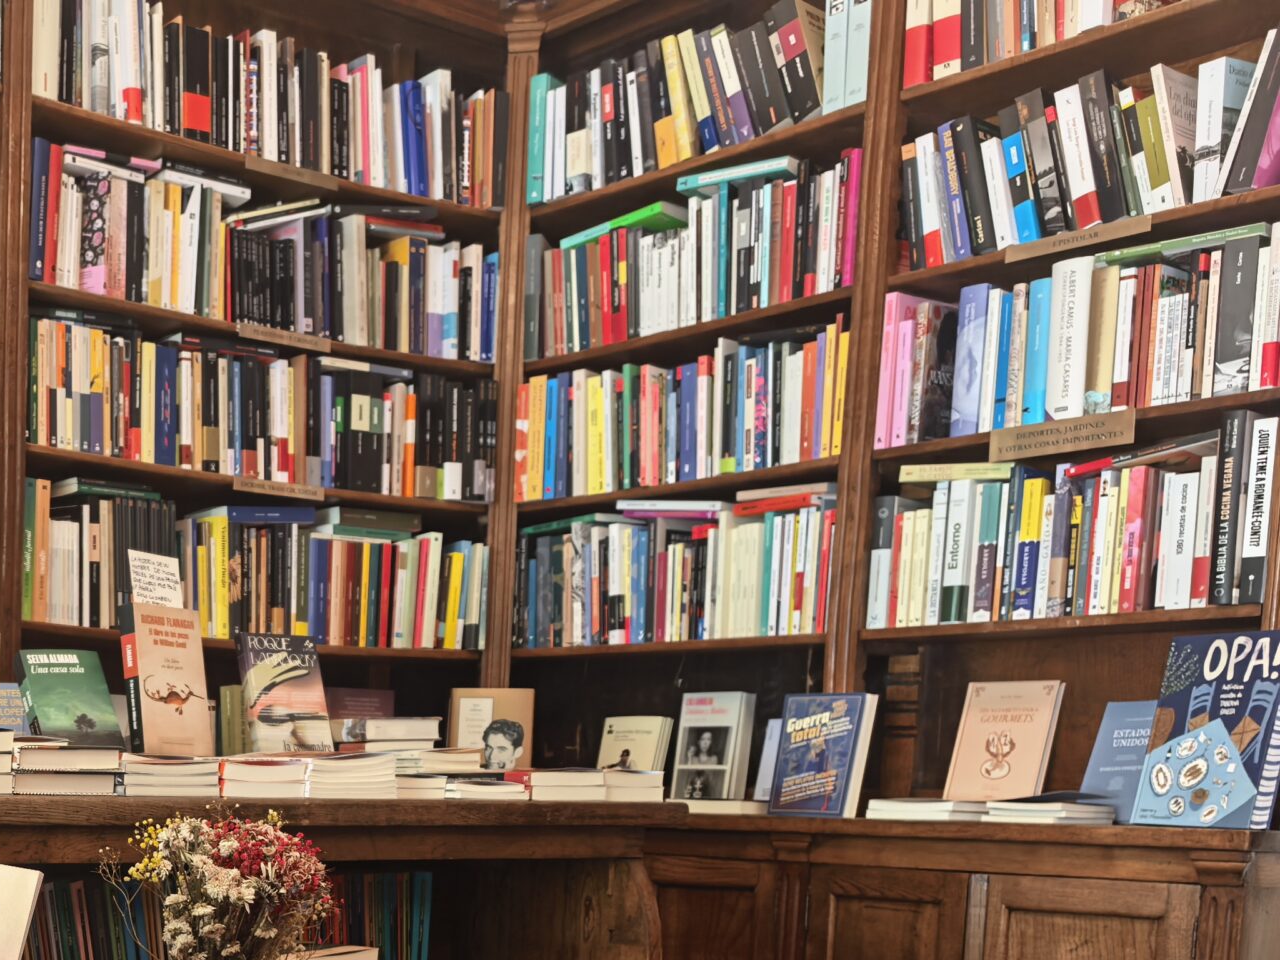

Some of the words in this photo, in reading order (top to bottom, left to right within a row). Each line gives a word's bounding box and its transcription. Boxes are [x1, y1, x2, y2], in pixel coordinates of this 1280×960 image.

[943, 130, 951, 148] RAY
[945, 150, 959, 195] BRADBURY
[975, 220, 984, 243] Cartas
[1052, 232, 1099, 248] EPISTOLAR
[1068, 269, 1077, 298] ALBERT
[1067, 300, 1076, 330] CAMUS
[1063, 336, 1073, 363] MARÍA
[1061, 364, 1071, 399] CASARES
[1005, 443, 1032, 454] OTRAS
[1034, 440, 1060, 450] COSAS
[1062, 431, 1124, 445] IMPORTANTES
[1016, 427, 1062, 441] DEPORTES,
[1064, 421, 1106, 436] JARDINES
[1258, 429, 1269, 455] ¿QUIÉN
[1222, 456, 1234, 489] VEGANA
[1257, 456, 1267, 473] TEME
[1220, 490, 1232, 521] COCINA
[1250, 483, 1266, 547] ROMANÉE-CONTI?
[1177, 514, 1186, 538] recetas
[1220, 521, 1229, 533] LA
[948, 522, 962, 571] Entorno
[1218, 534, 1228, 545] DE
[1021, 546, 1030, 585] MARIPOSAS
[1217, 546, 1226, 571] BIBLIA
[1216, 573, 1224, 584] LA
[141, 614, 164, 626] RICHARD
[166, 616, 195, 630] FLANAGAN
[248, 636, 291, 650] ROQUE
[27, 654, 48, 664] SELVA
[49, 654, 79, 664] ALMADA
[31, 665, 48, 674] Una
[50, 666, 67, 674] casa
[68, 665, 85, 674] sola
[1203, 636, 1280, 682] OPA!
[786, 711, 831, 733] Guerra
[1112, 728, 1151, 738] ESTADO
[791, 727, 820, 743] total
[1112, 737, 1149, 747] UNIDOS
